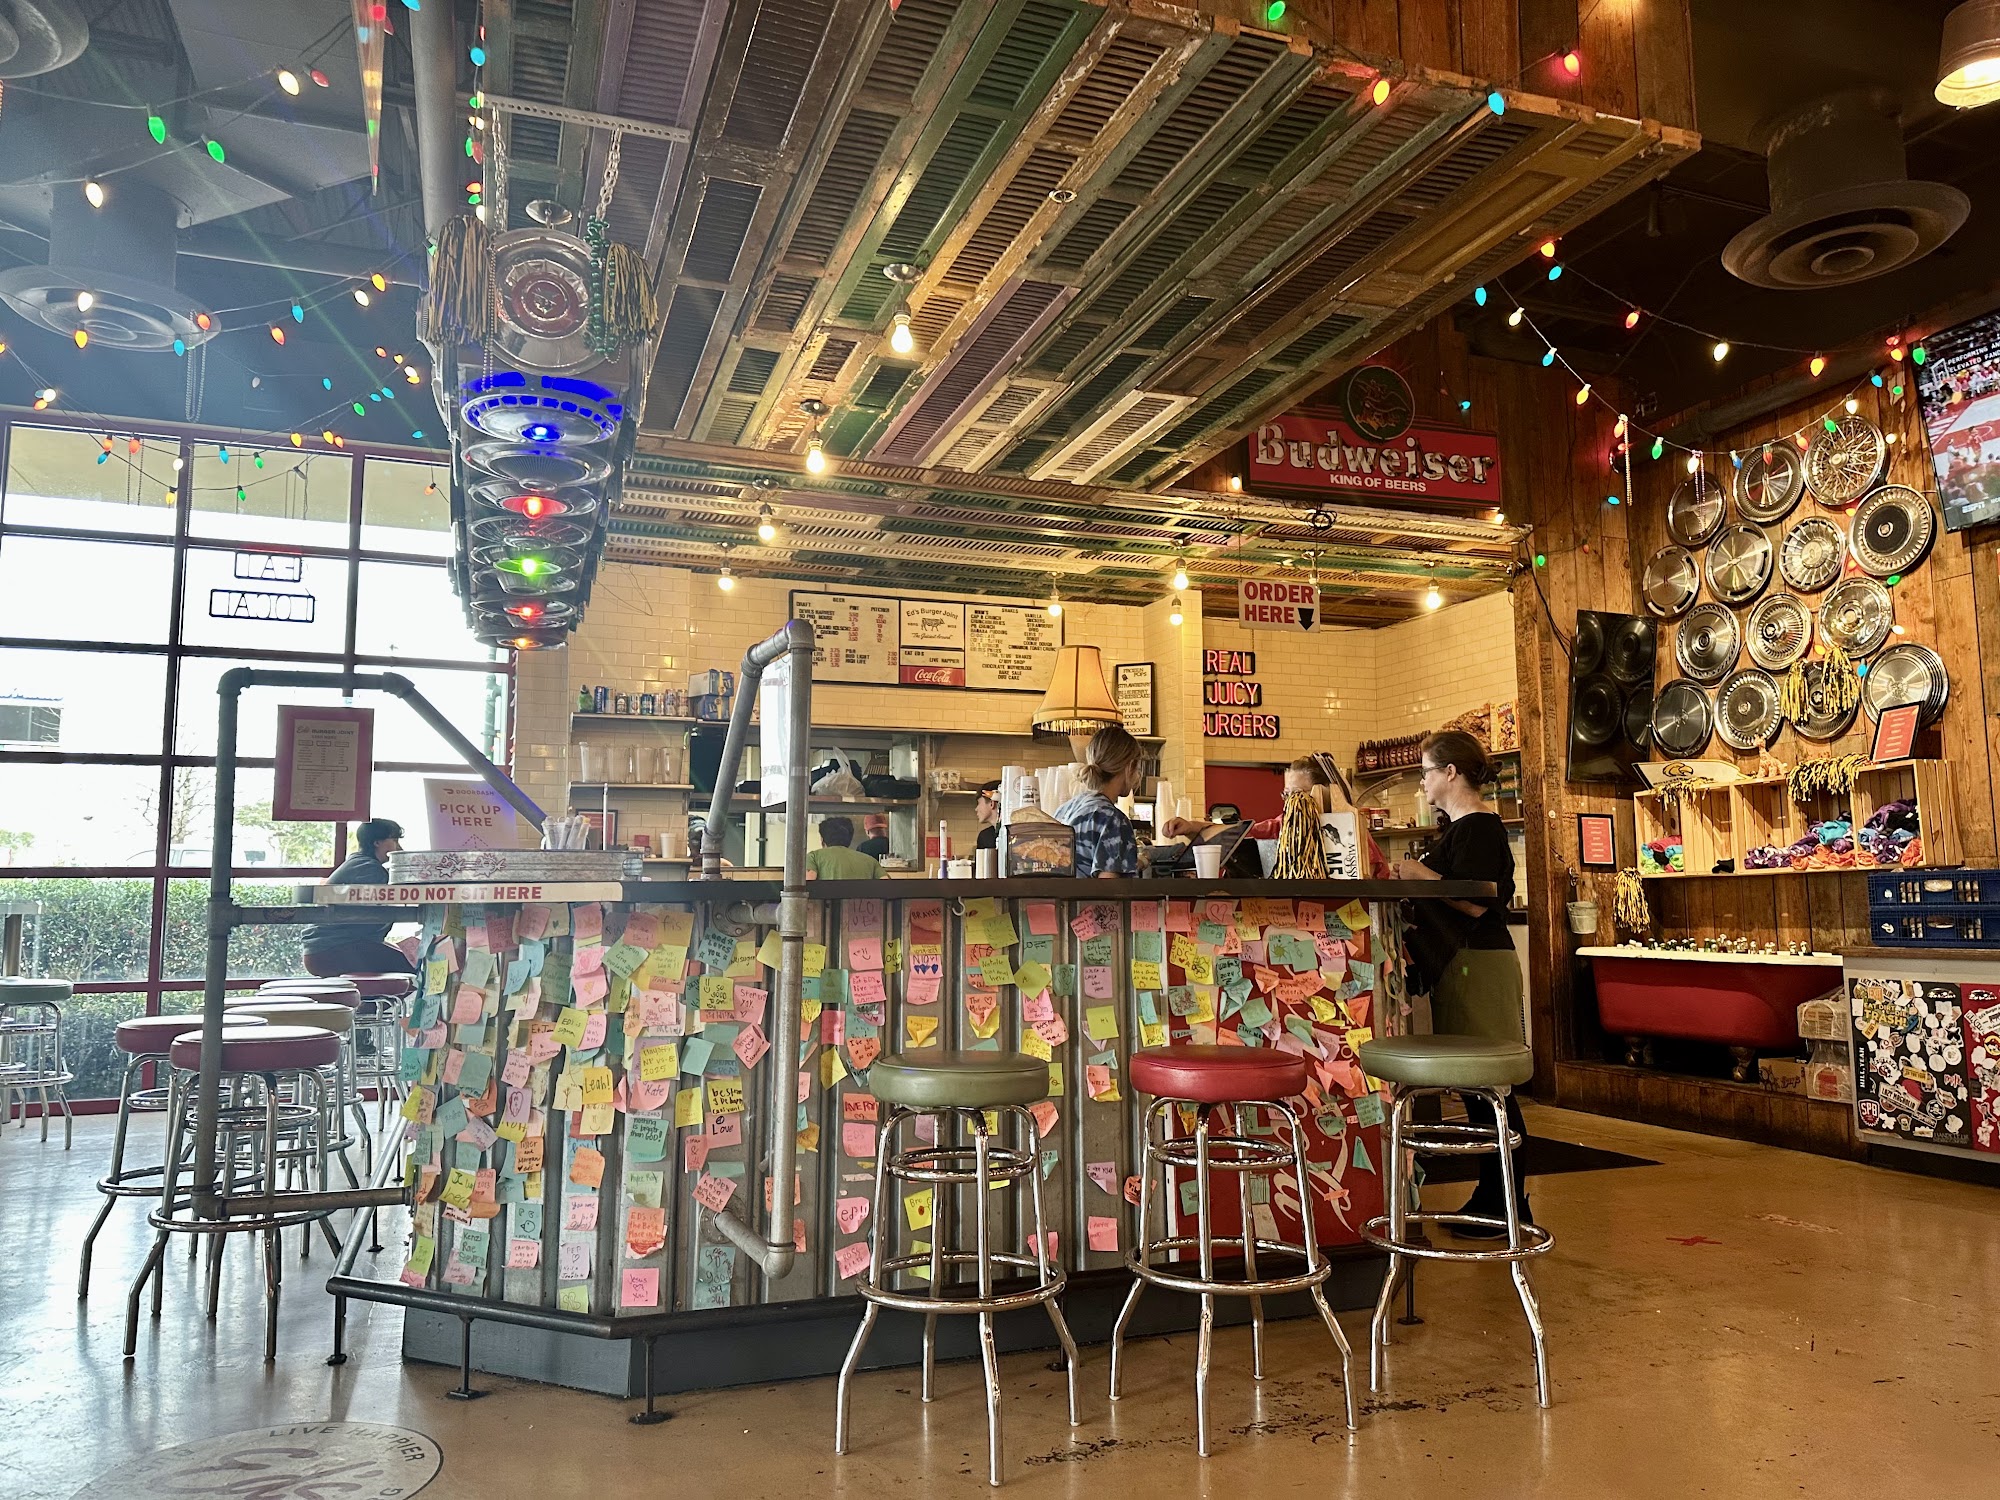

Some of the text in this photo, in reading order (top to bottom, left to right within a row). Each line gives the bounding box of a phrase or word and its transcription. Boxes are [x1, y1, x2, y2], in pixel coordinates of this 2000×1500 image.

[1947, 346, 1988, 365] PERFORMING
[1947, 356, 1982, 373] ELEVATED
[1255, 424, 1494, 484] Budweiser
[1330, 474, 1427, 492] KING OF BEERS
[1244, 582, 1314, 604] ORDER
[906, 609, 920, 617] Ed's
[943, 610, 958, 620] Joint
[1244, 604, 1295, 624] HERE
[1206, 650, 1253, 674] REAL
[1208, 682, 1258, 706] JUICY
[439, 803, 501, 815] PICK UP
[452, 816, 493, 827] HERE
[349, 886, 542, 901] PLEASE DO NOT SIT HERE
[1863, 1009, 1908, 1027] TRASH!
[585, 1074, 611, 1094] Leah!
[1881, 1087, 1893, 1097] LAZY
[844, 1101, 876, 1112] AVERY
[1861, 1102, 1878, 1116] SPB
[712, 1124, 734, 1135] Love
[269, 1426, 425, 1463] LIVE HAPPIER
